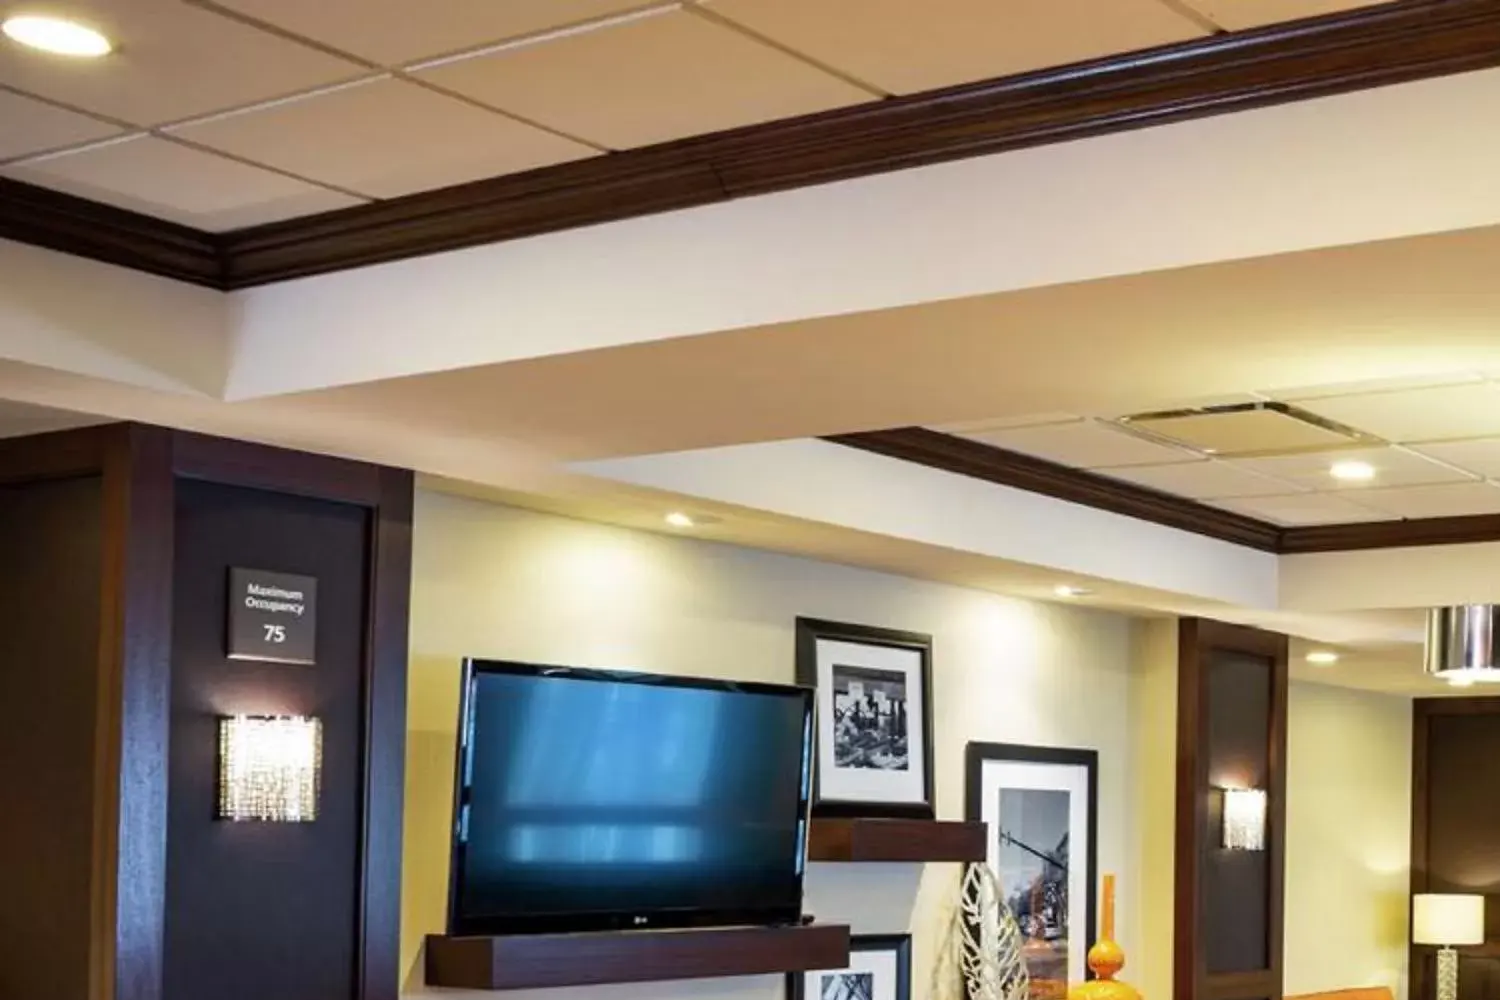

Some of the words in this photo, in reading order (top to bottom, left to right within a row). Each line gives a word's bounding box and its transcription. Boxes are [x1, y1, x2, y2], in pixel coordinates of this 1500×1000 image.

[247, 583, 303, 600] Maximum
[245, 596, 304, 615] Occupancy
[263, 624, 286, 642] 75
